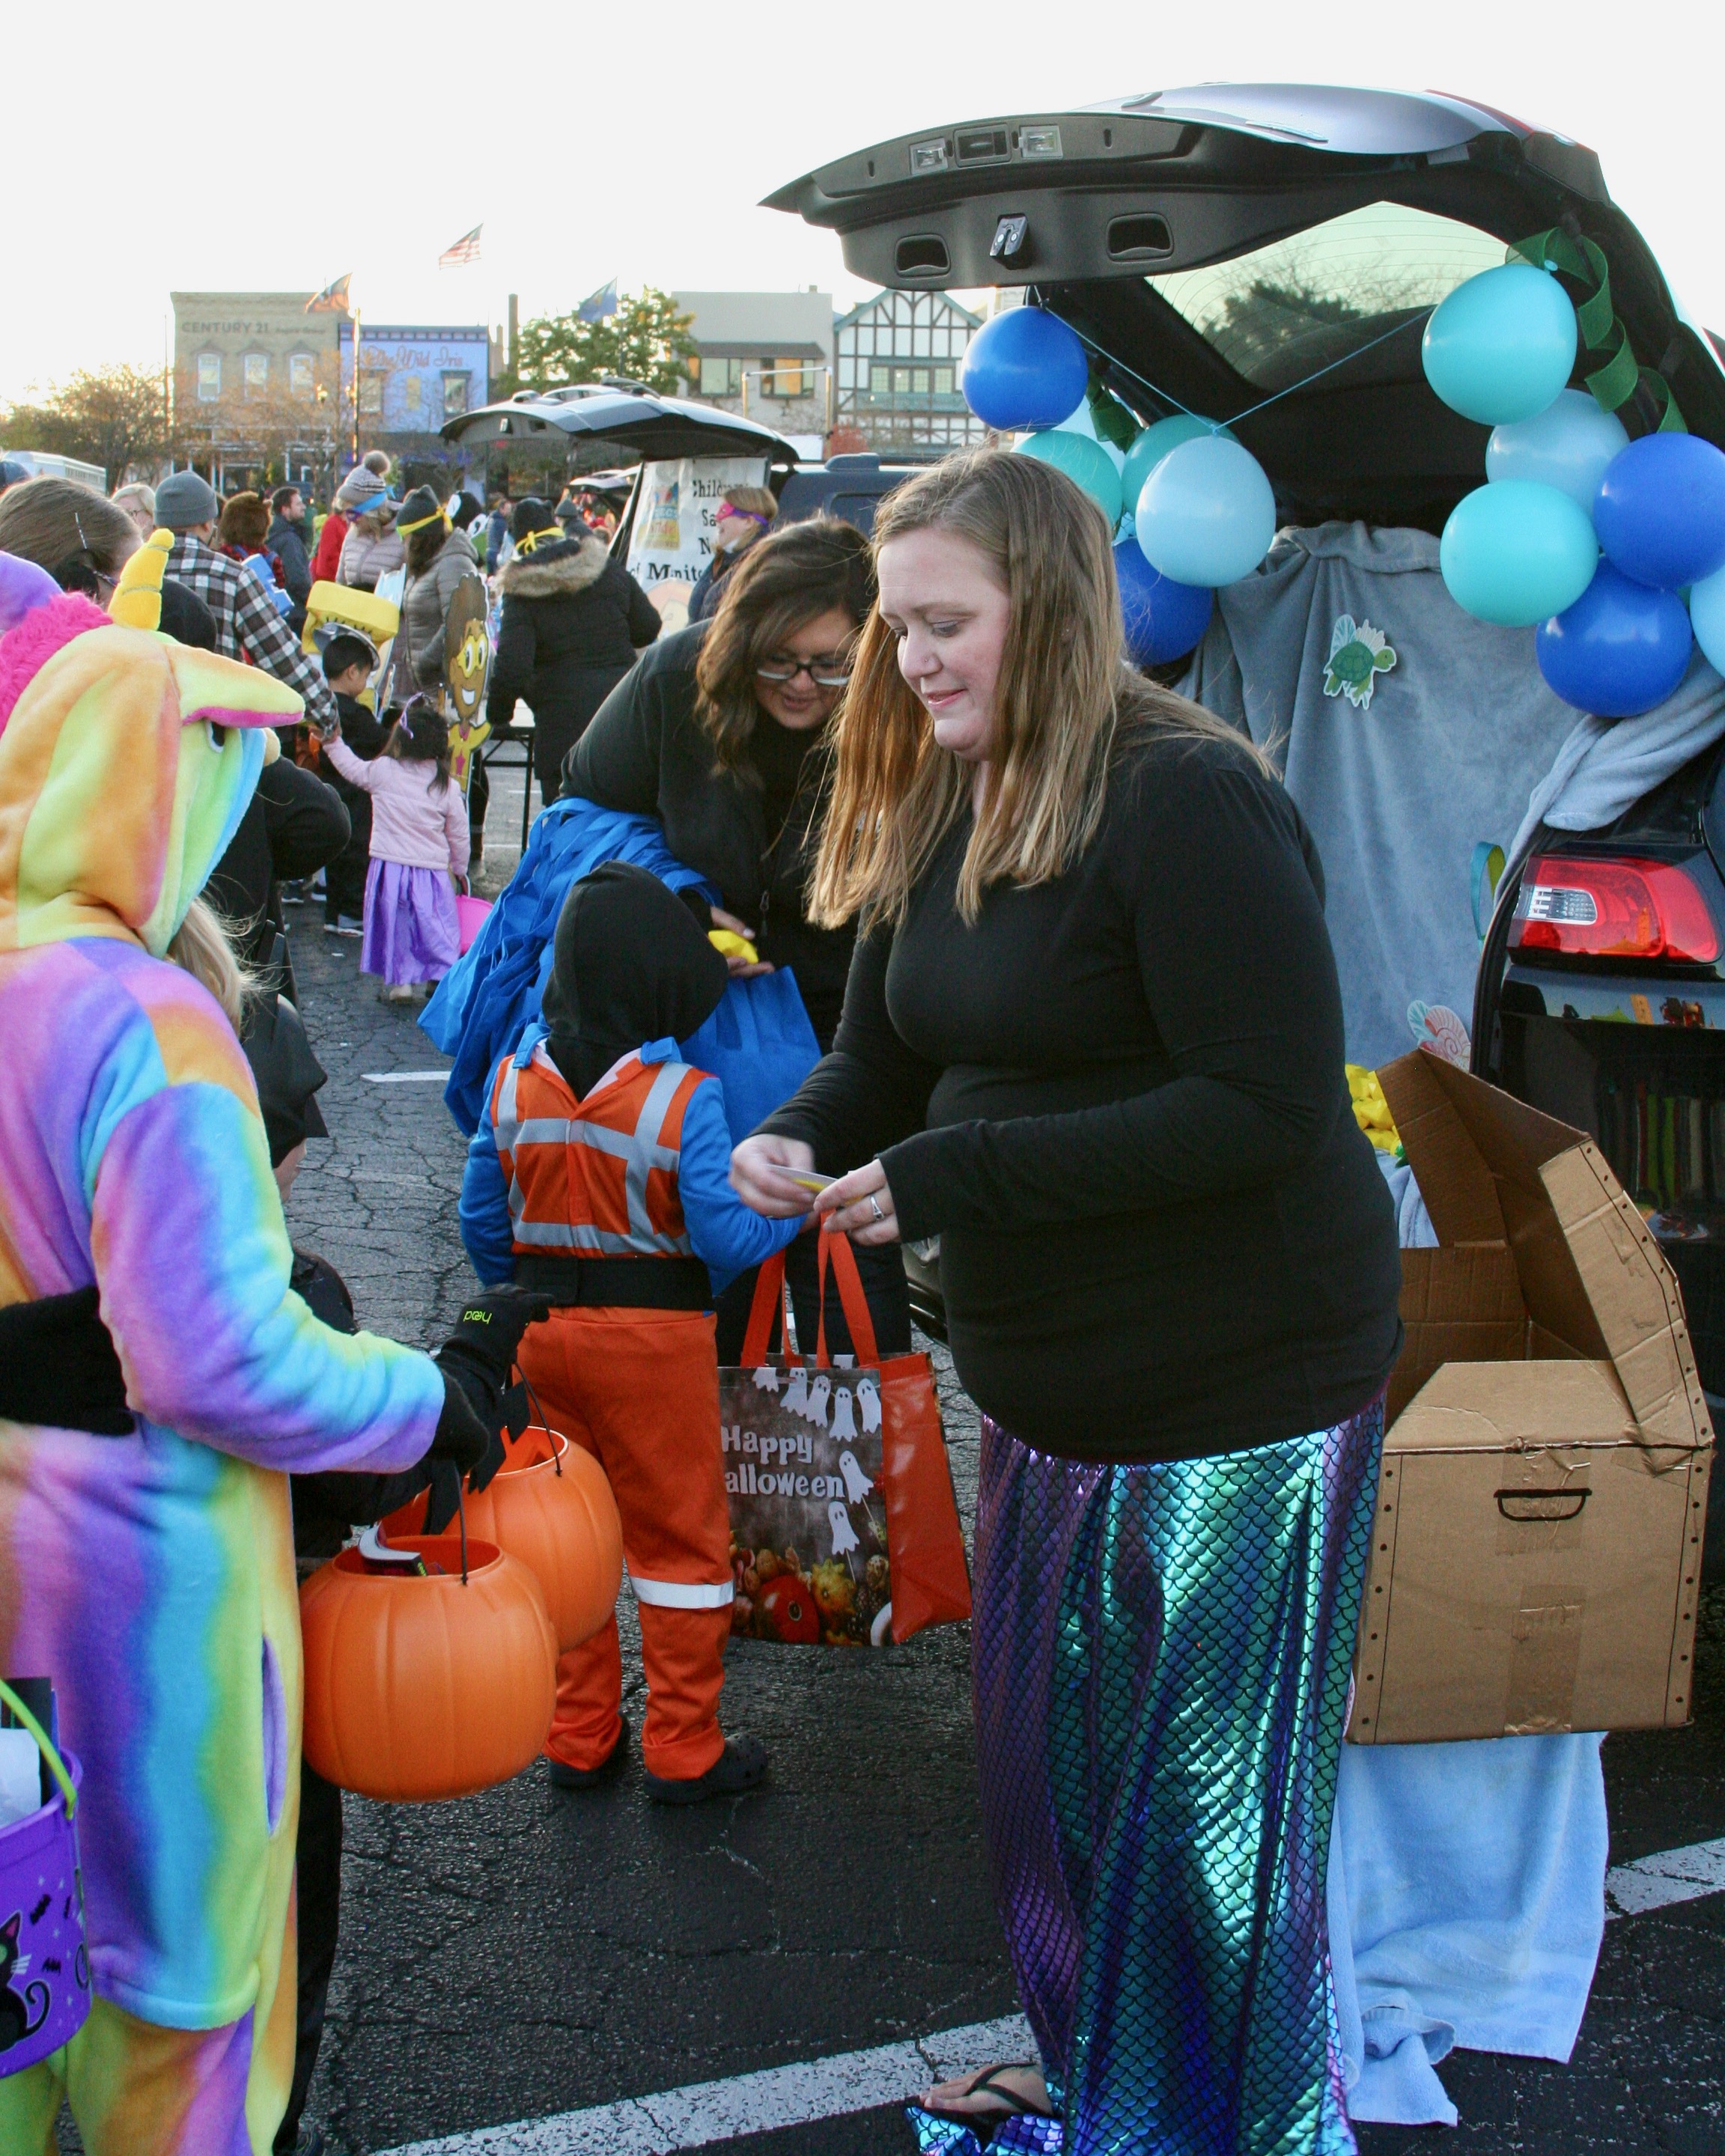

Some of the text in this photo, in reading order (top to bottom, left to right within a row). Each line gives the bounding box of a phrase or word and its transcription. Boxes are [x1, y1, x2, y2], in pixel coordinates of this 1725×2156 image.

[182, 321, 252, 334] CENTURY
[255, 321, 270, 334] 21
[721, 1425, 813, 1466] Happy
[724, 1463, 845, 1498] alloween
